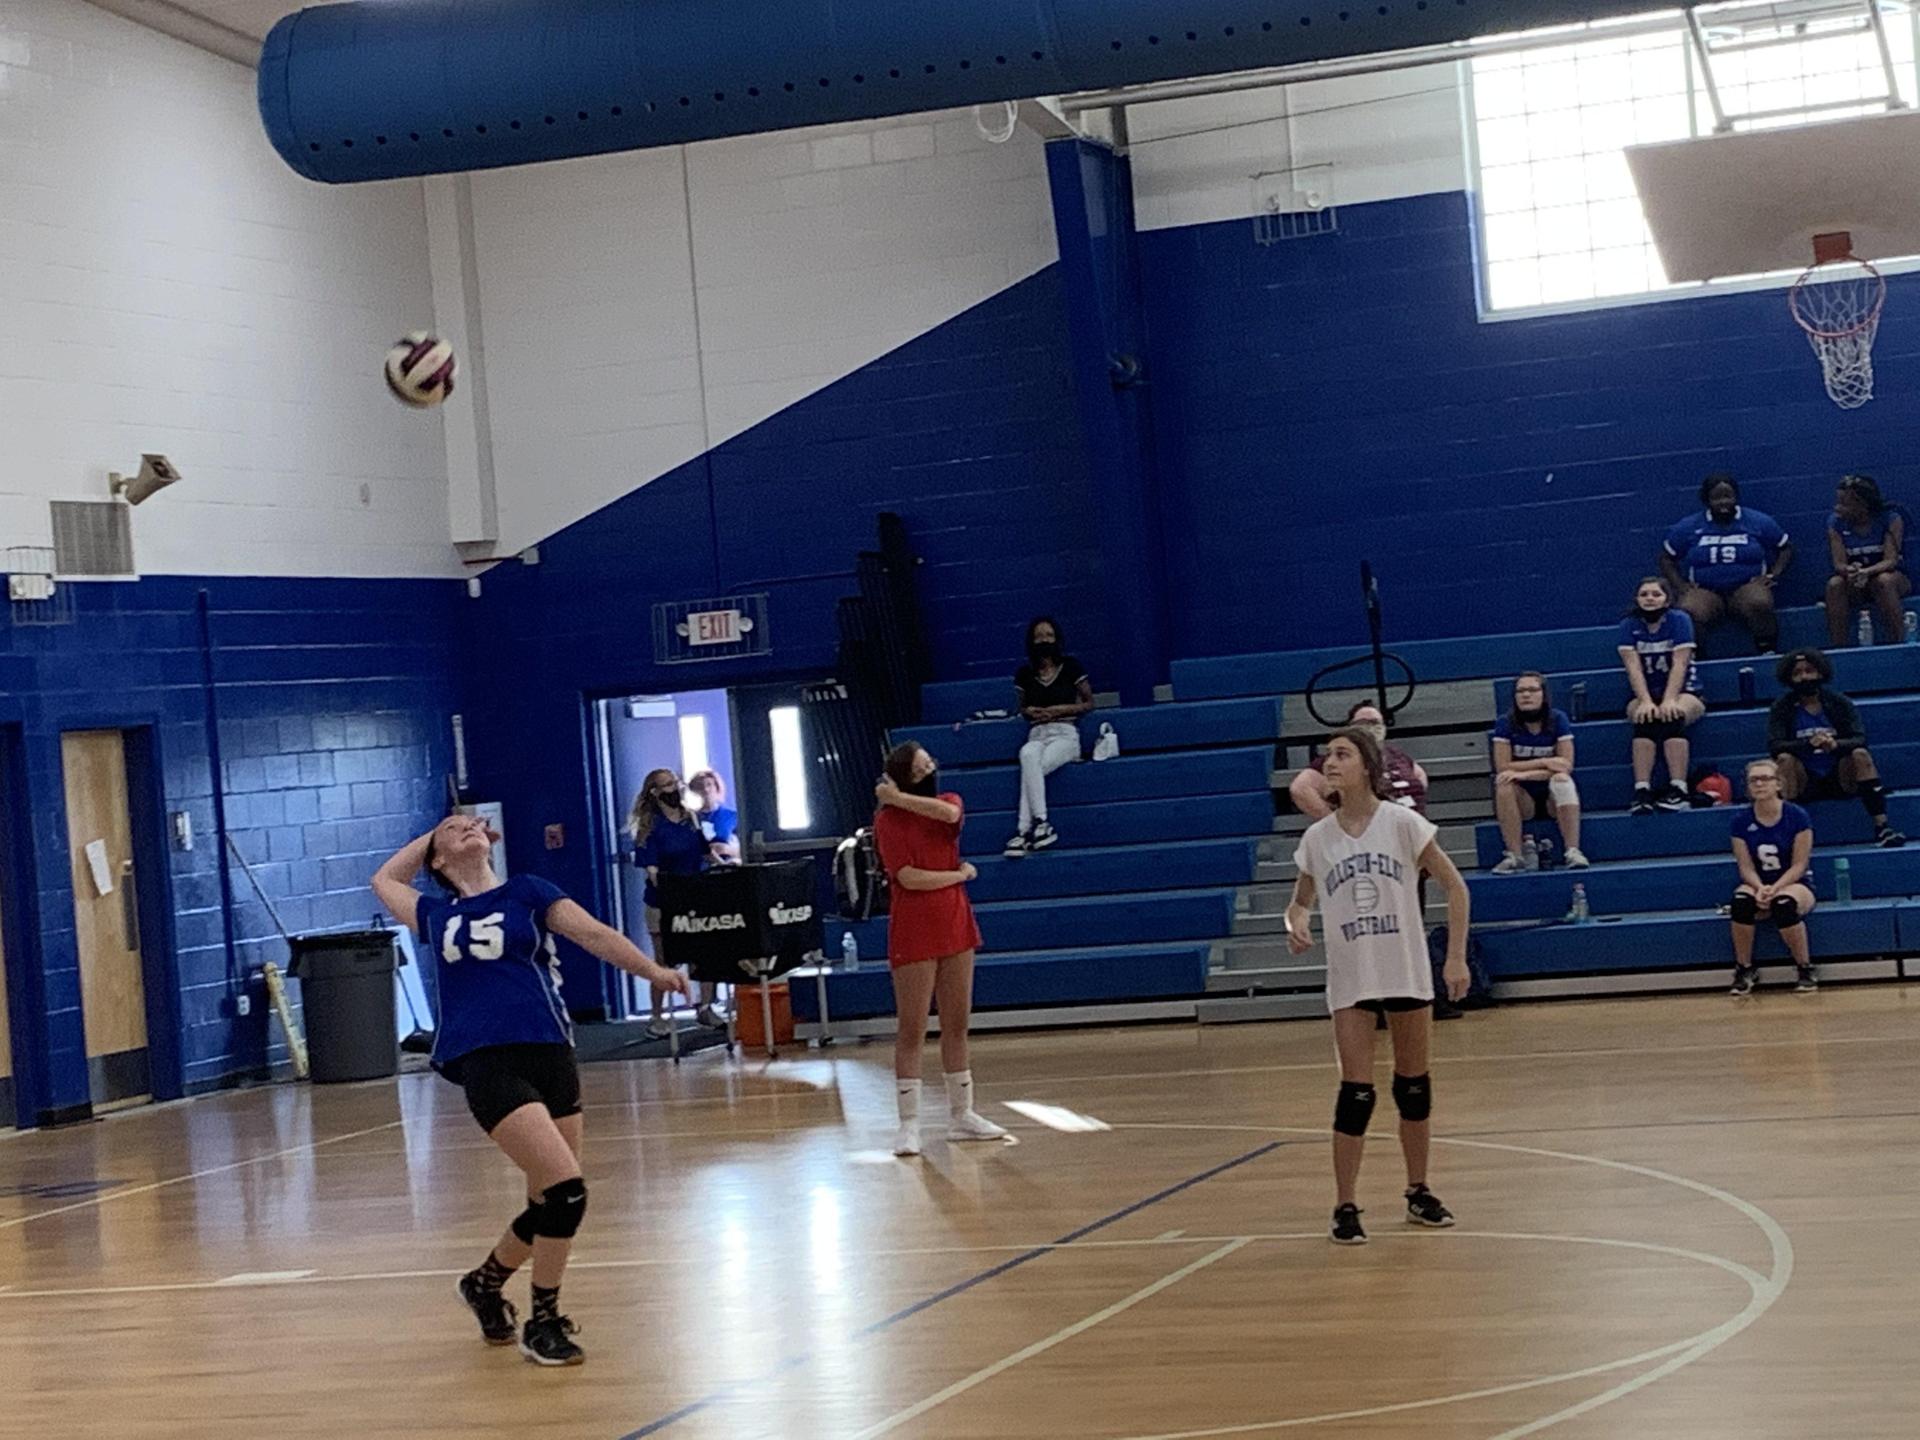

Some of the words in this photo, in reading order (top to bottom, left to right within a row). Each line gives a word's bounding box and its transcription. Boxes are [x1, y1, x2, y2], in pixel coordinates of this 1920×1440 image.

[699, 612, 731, 641] EXIT
[1644, 655, 1669, 674] 14
[442, 911, 505, 964] 15
